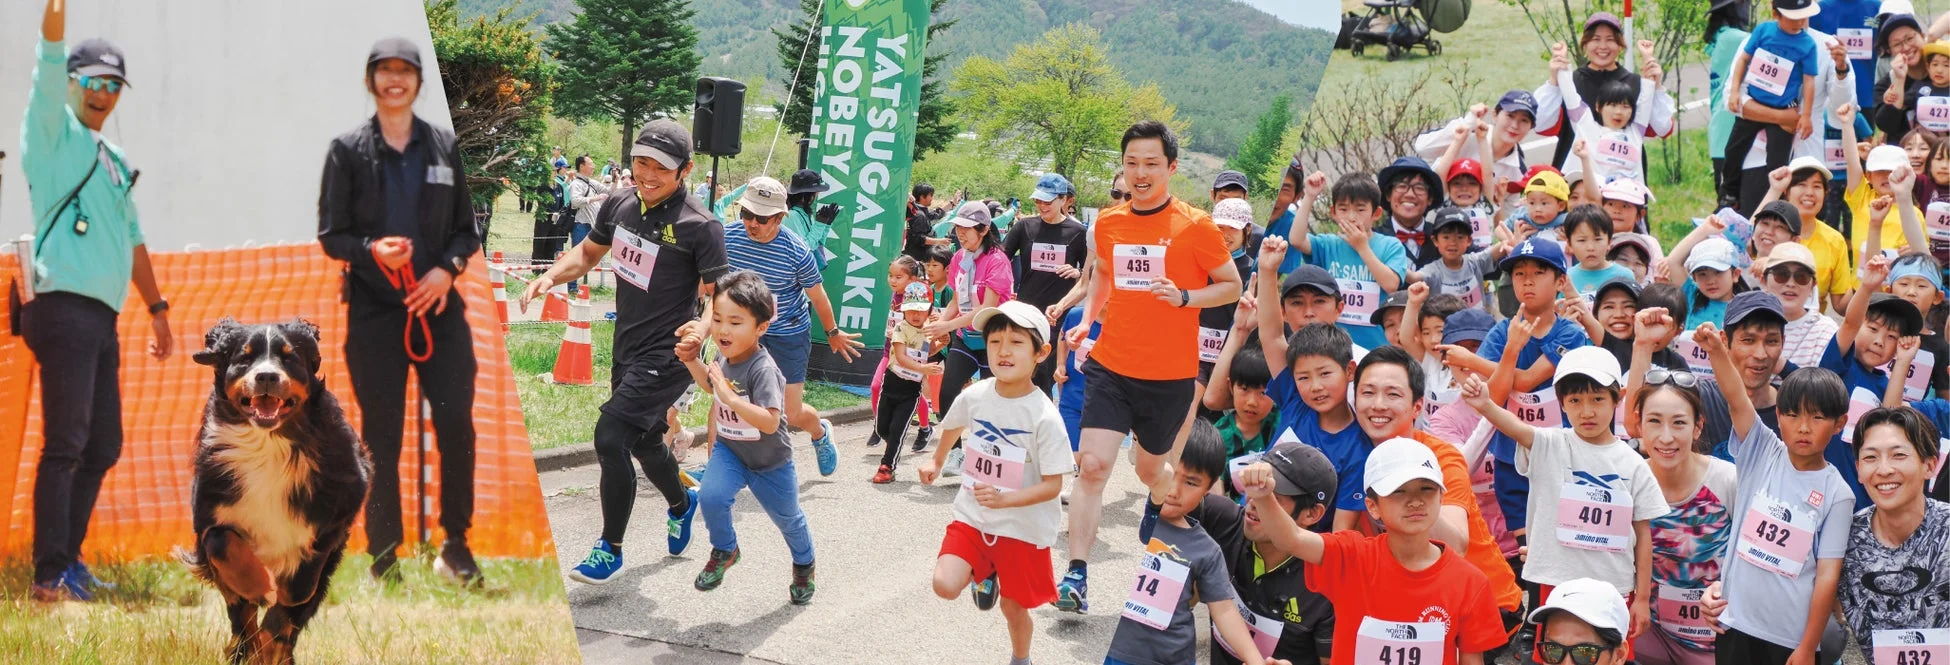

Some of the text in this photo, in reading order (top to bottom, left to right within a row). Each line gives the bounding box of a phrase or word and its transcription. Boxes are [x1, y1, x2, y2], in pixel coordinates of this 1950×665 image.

[1759, 63, 1778, 78] 439
[1929, 107, 1949, 118] 427
[1609, 142, 1629, 155] 415
[839, 33, 909, 330] YATSUGATAKE
[1938, 214, 1950, 226] 42
[1521, 239, 1535, 255] LA
[621, 246, 642, 267] 414
[1040, 252, 1056, 262] 413
[1126, 259, 1151, 273] 435
[1202, 338, 1222, 351] 402
[1691, 346, 1708, 360] 45
[1887, 358, 1916, 379] 46
[1425, 402, 1439, 415] 48
[1517, 407, 1546, 422] 464
[975, 457, 1003, 479] 401
[1579, 505, 1613, 527] 401
[1756, 519, 1791, 548] 432
[1764, 554, 1782, 565] VITAL
[1136, 574, 1160, 597] 14
[1132, 605, 1149, 616] VITAL
[1678, 604, 1700, 620] 40
[1379, 645, 1422, 665] 419
[1897, 650, 1932, 665] 432
